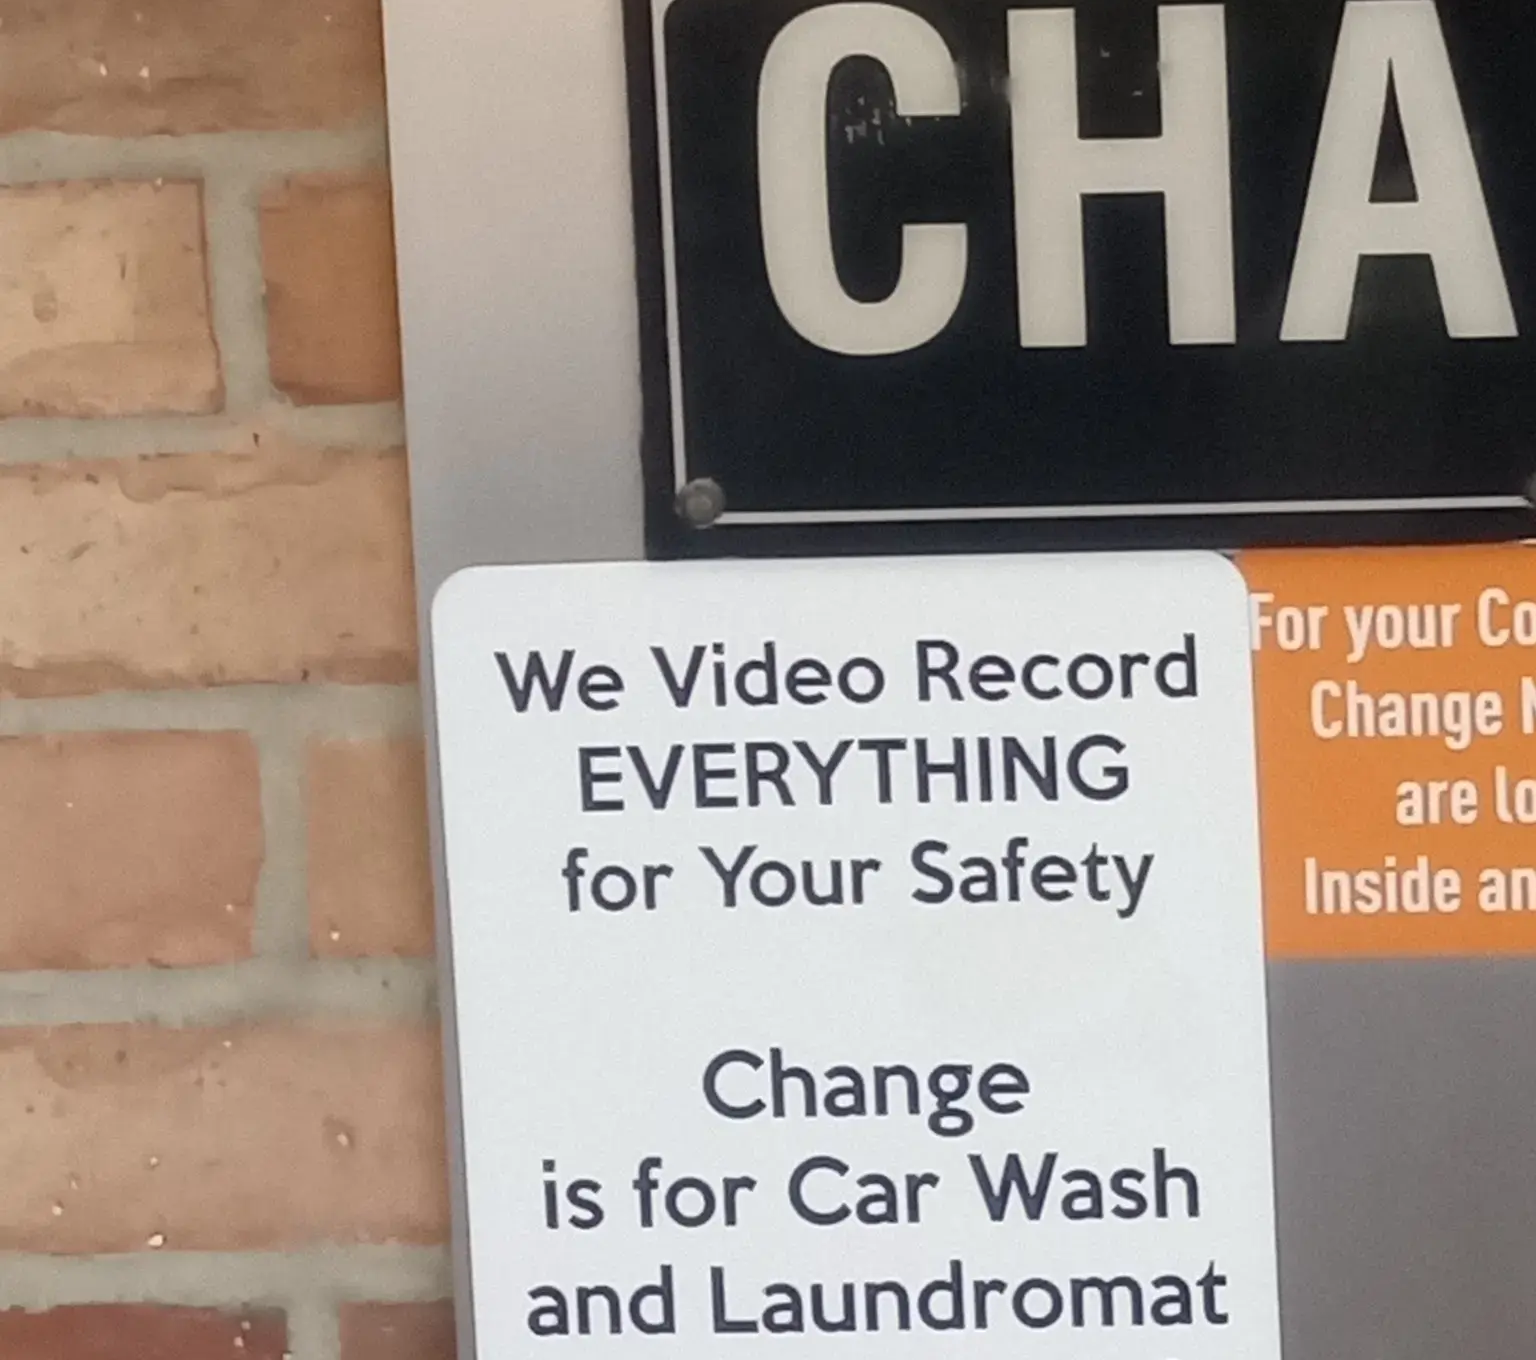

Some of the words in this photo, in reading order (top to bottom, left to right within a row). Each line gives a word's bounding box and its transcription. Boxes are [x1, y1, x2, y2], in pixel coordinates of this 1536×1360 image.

[1249, 592, 1328, 652] For
[1343, 603, 1462, 664] your
[493, 649, 625, 713] We
[650, 640, 885, 708] Video
[916, 632, 1198, 702] Record
[1311, 679, 1503, 750] Change
[578, 734, 1129, 812] EVERYTHING
[1396, 780, 1478, 825] are
[561, 847, 674, 913] for
[698, 844, 882, 908] Your
[911, 836, 1155, 919] Safety
[1304, 855, 1461, 915] Inside
[702, 1047, 1030, 1138] Change
[542, 1159, 605, 1230] is
[632, 1156, 757, 1228] for
[788, 1155, 940, 1226] Car
[967, 1147, 1200, 1222] Wash
[527, 1264, 676, 1337] and
[710, 1259, 1229, 1334] Laundromat
